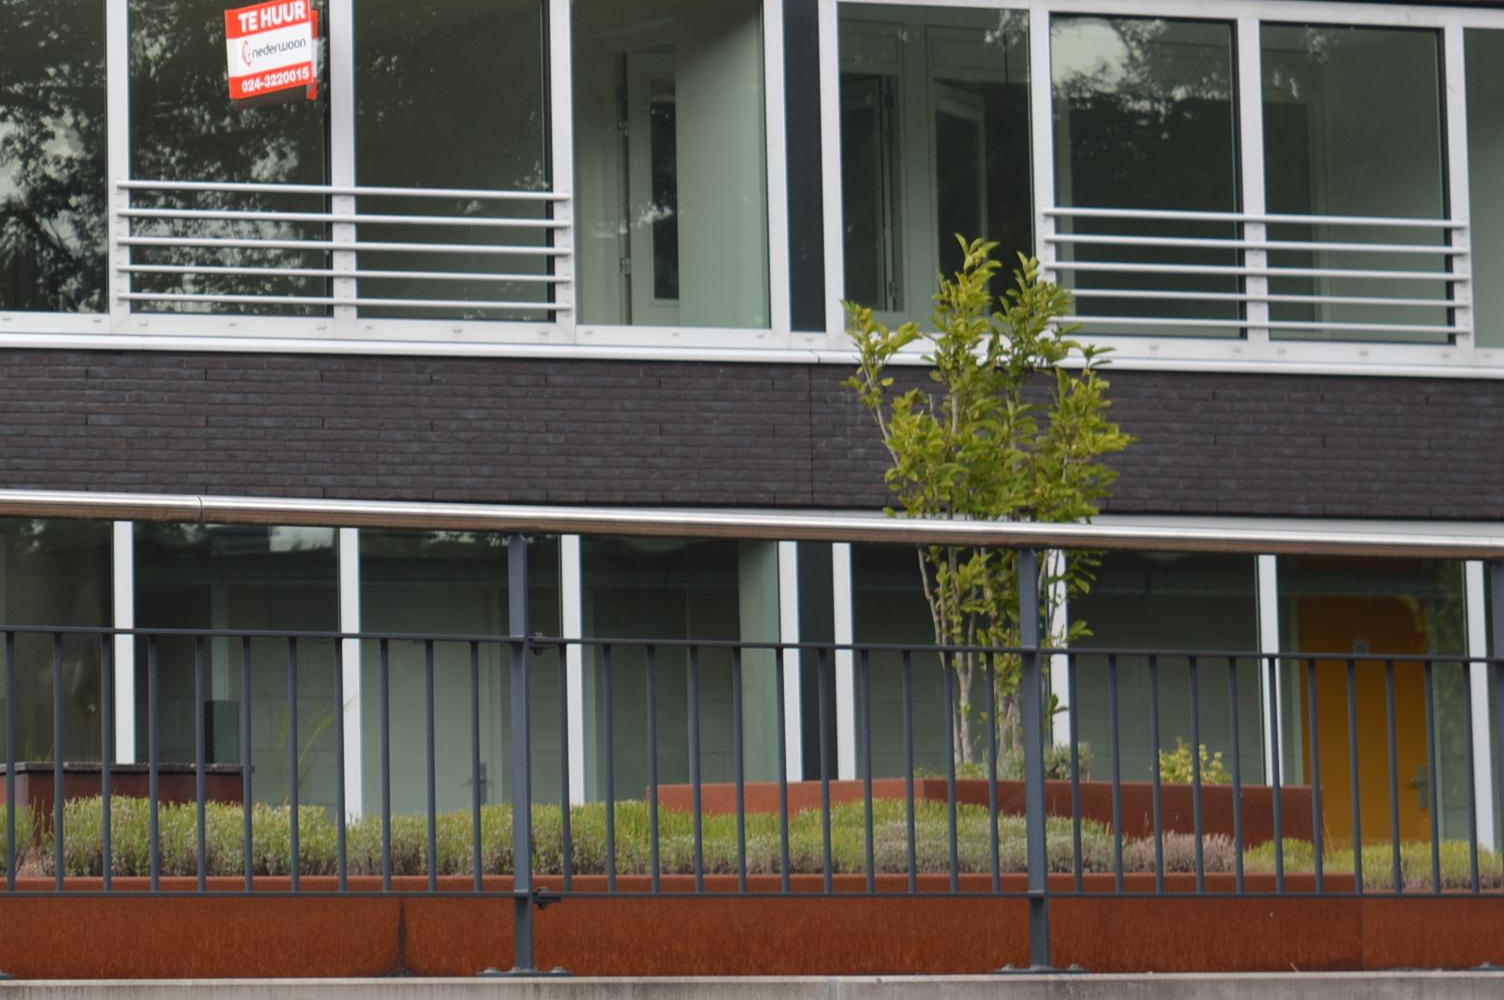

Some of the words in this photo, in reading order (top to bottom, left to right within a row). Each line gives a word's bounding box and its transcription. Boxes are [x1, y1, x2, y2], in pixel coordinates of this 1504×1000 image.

[238, 10, 258, 33] TE
[260, 0, 306, 28] HUUR
[252, 38, 307, 58] nederwoon
[241, 66, 310, 93] 024-3220015
